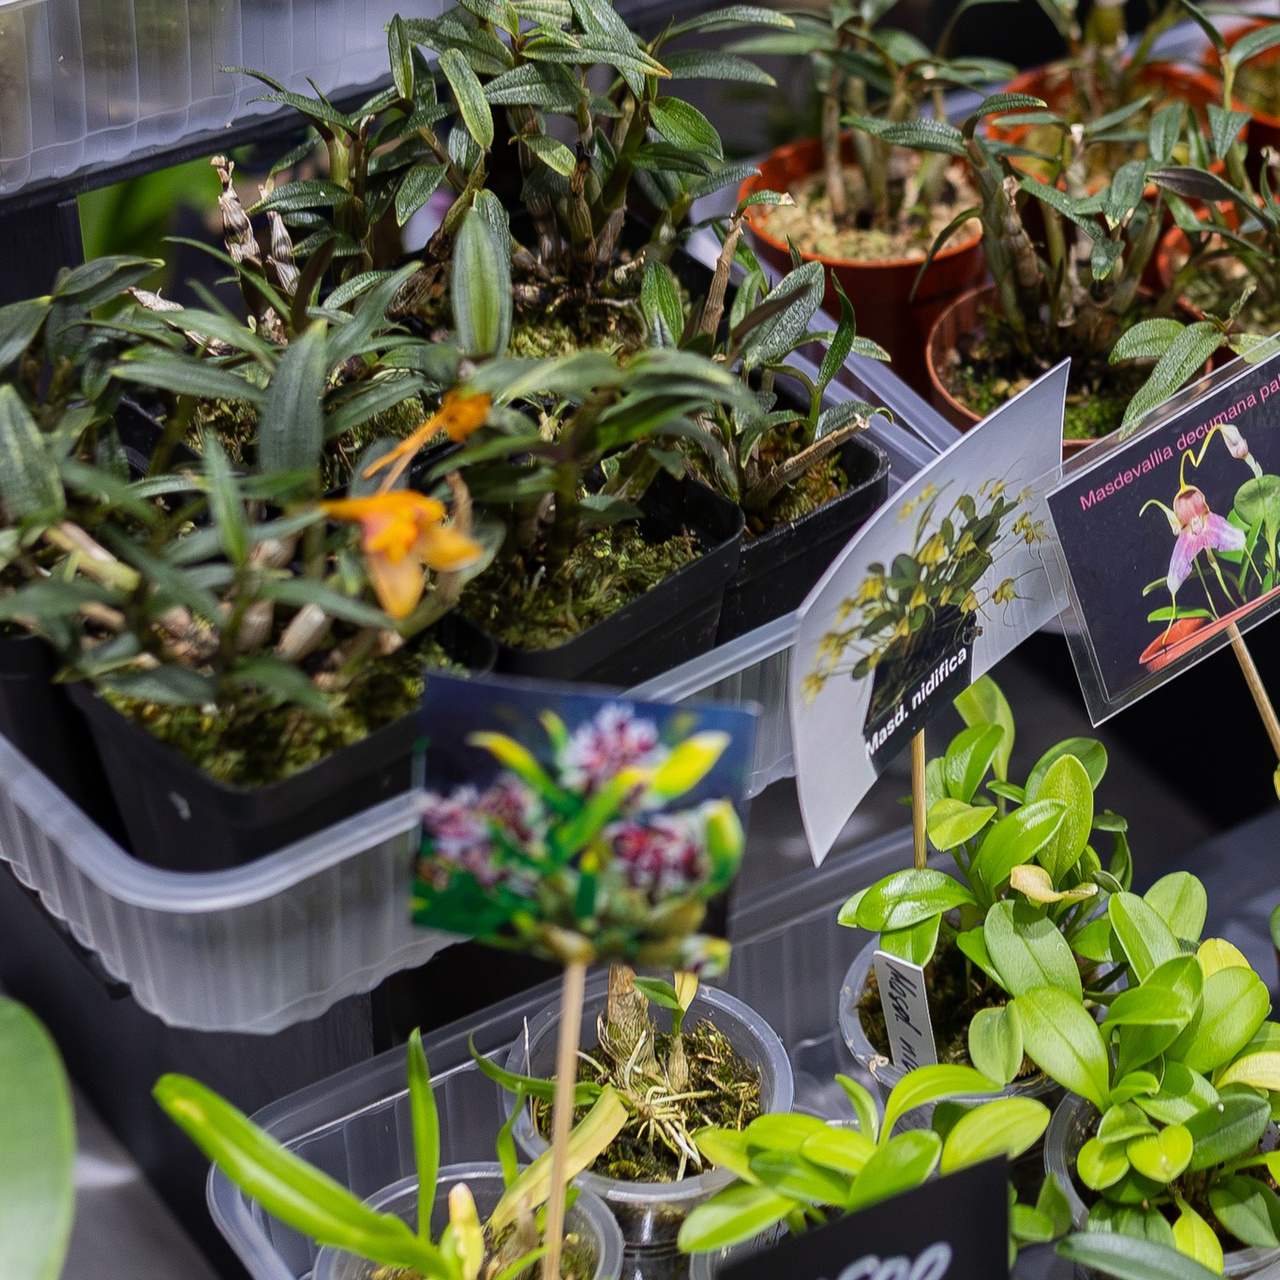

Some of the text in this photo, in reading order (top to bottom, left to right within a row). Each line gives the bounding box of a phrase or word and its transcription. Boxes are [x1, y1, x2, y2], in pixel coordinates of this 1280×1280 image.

[1079, 444, 1174, 511] Masdevallia
[1175, 392, 1258, 452] decumana
[864, 647, 967, 761] Masd. nidifica
